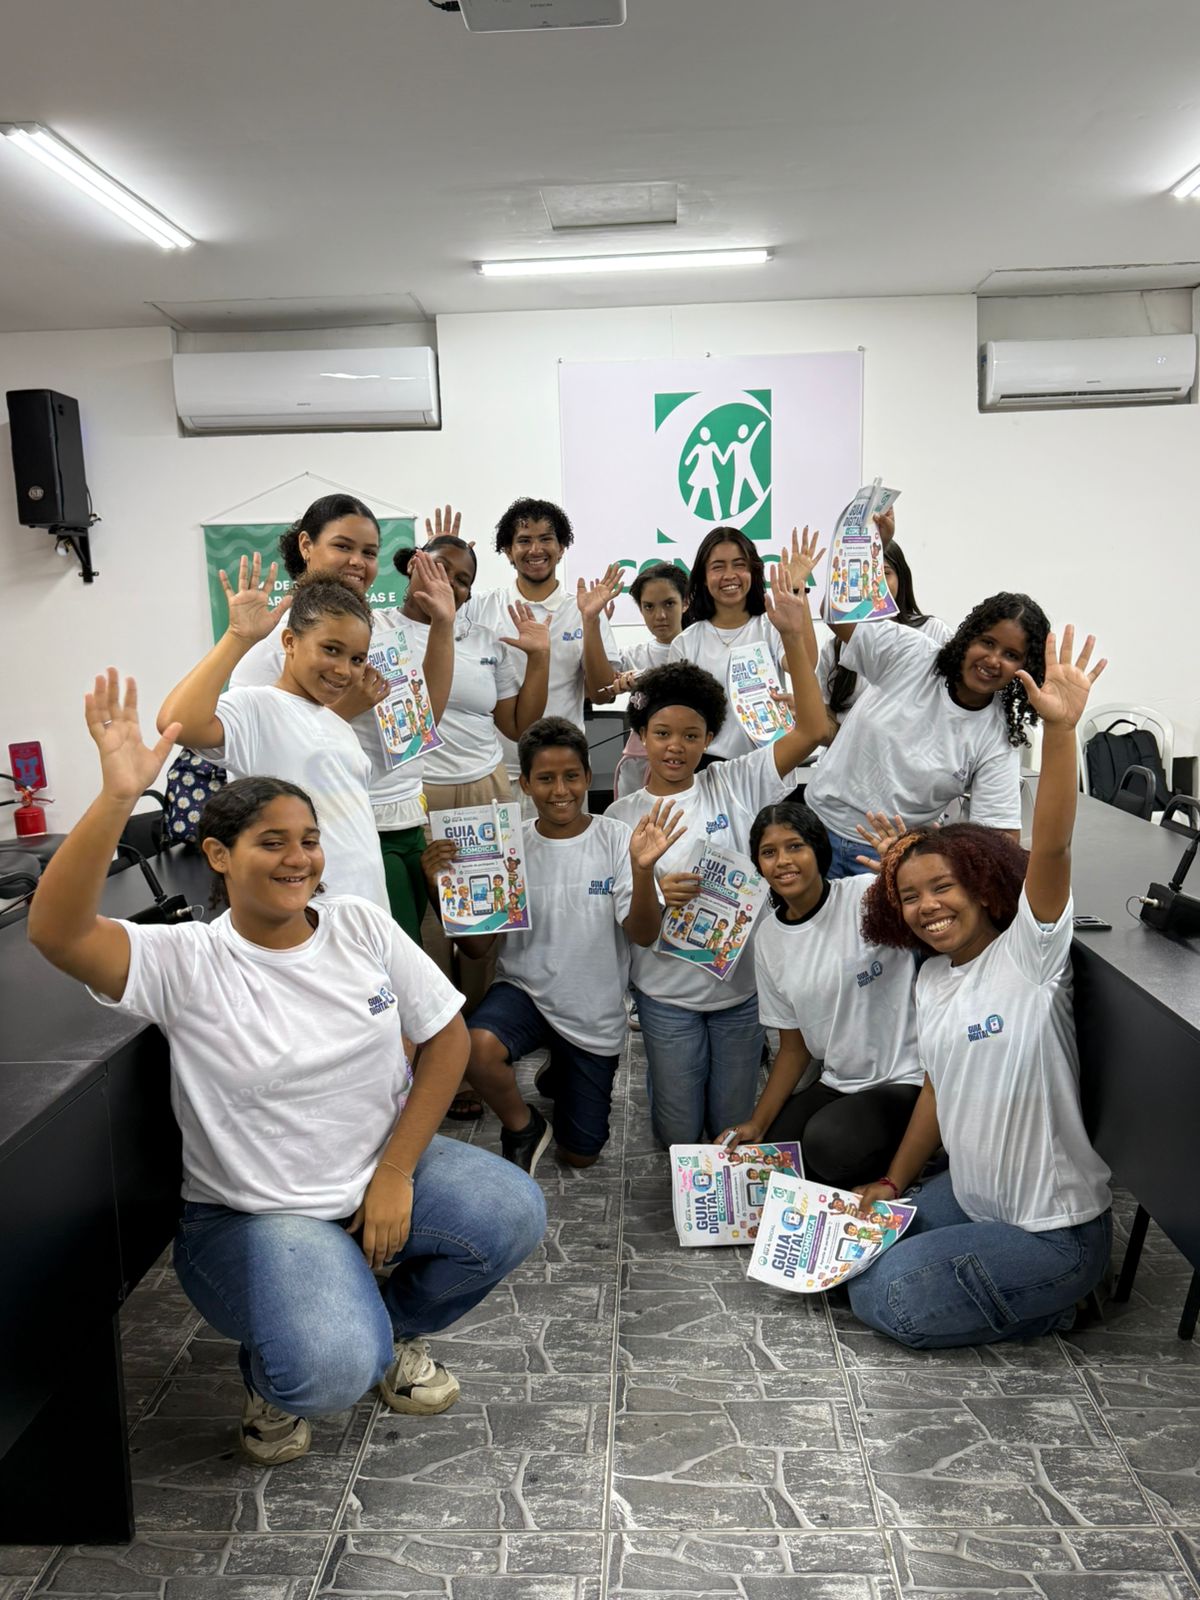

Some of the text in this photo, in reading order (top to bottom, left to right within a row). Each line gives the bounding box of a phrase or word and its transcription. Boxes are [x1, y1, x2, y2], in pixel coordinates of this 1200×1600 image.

[274, 580, 290, 591] DE
[389, 592, 396, 602] E
[445, 825, 475, 838] GUIA
[461, 845, 495, 854] COMDICA
[692, 865, 726, 887] DGITAL
[704, 880, 736, 897] COMDICA
[367, 995, 383, 1007] GUIA
[369, 1000, 390, 1016] DIGITAL
[967, 1023, 982, 1034] GUIA
[717, 1174, 725, 1213] COMDICA
[695, 1196, 708, 1230] GUIA
[706, 1189, 719, 1234] DIGITAL
[801, 1219, 816, 1259] COMDICA
[771, 1234, 792, 1270] GUIA
[783, 1232, 804, 1279] DIGITAL
